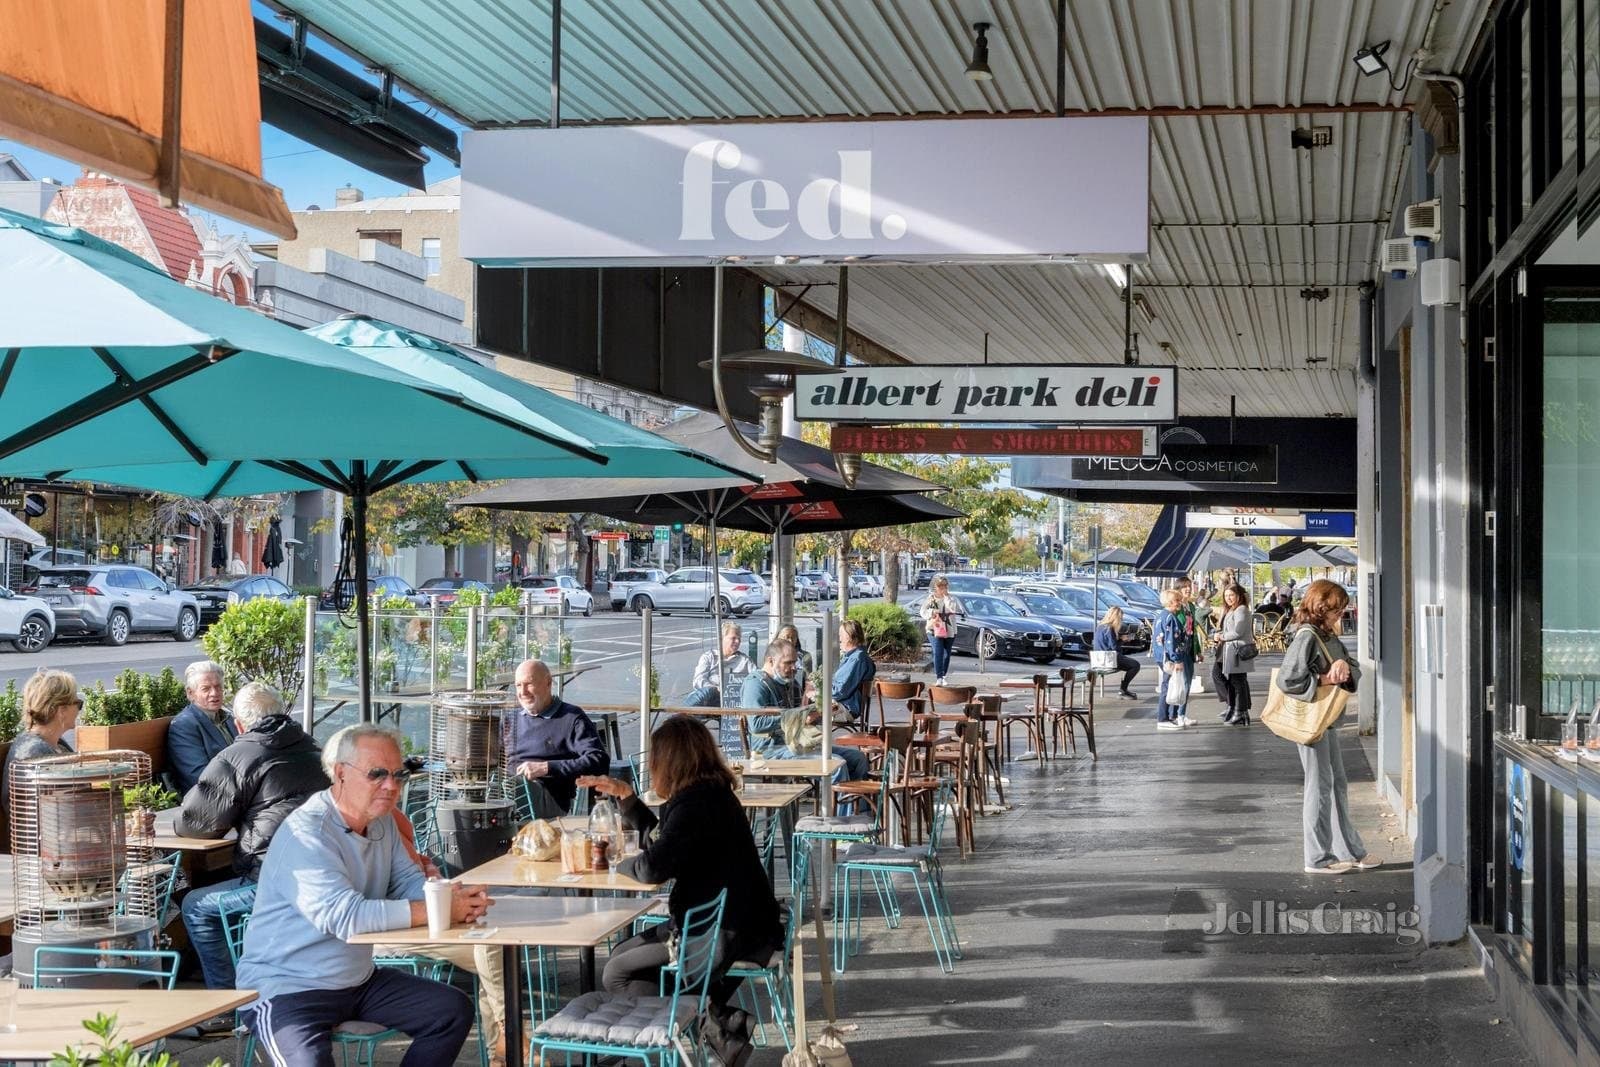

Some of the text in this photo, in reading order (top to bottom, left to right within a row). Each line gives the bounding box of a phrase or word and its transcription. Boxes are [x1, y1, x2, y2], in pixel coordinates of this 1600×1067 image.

[679, 139, 907, 241] fed.
[810, 376, 1160, 415] albert park deli
[840, 432, 1133, 450] JUICES & SMOOTHIES
[1088, 454, 1259, 472] MECCA COSMETICA
[1233, 517, 1257, 525] ELK
